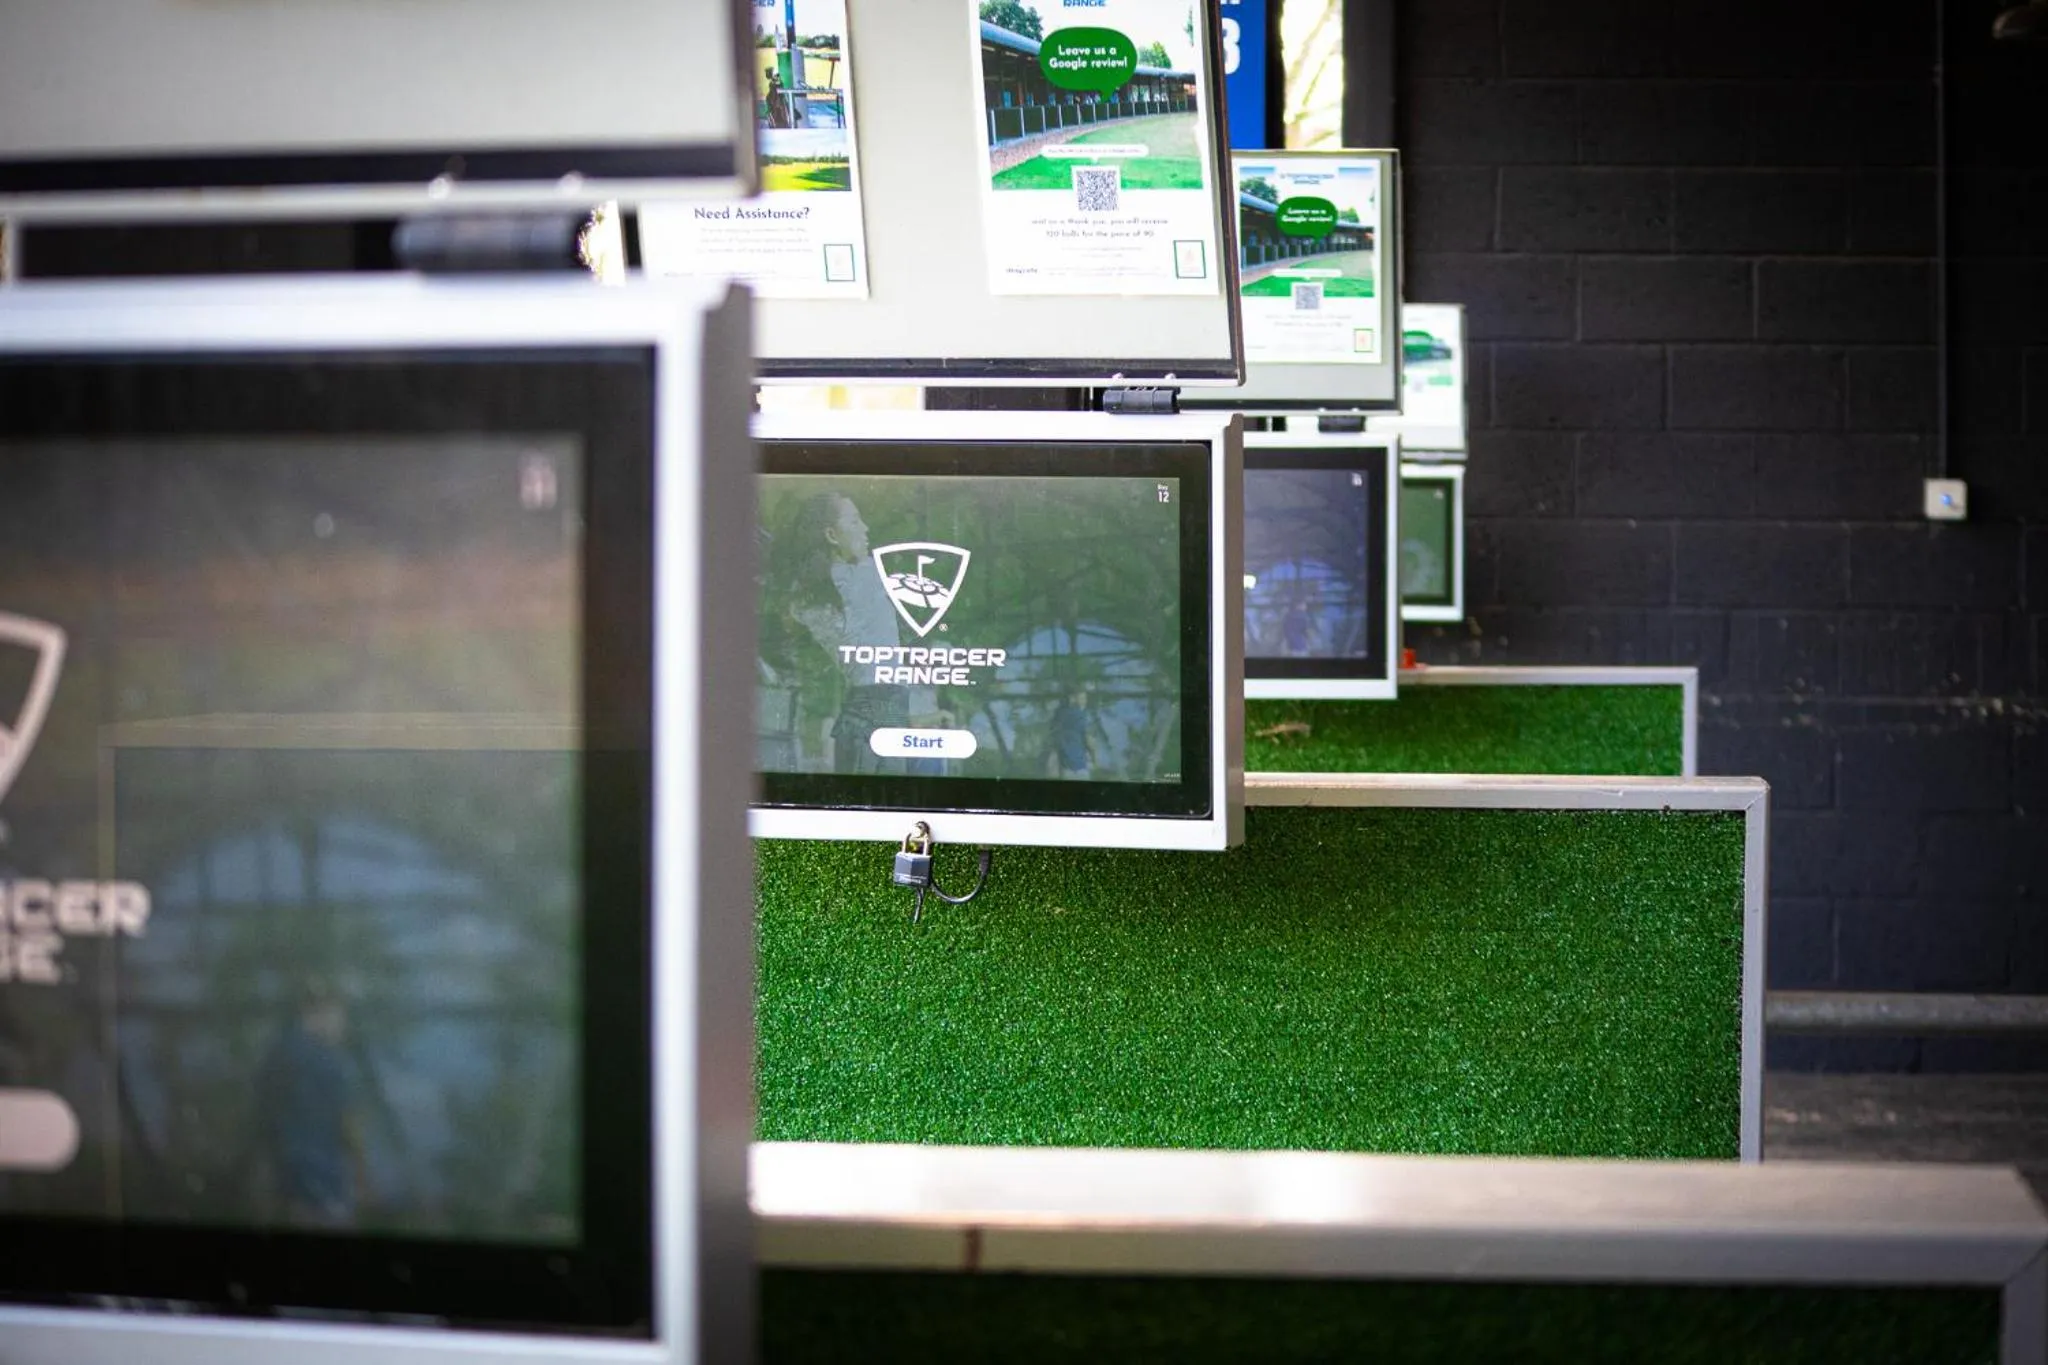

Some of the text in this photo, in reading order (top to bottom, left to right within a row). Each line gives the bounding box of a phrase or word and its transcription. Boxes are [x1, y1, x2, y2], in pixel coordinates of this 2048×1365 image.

[1058, 44, 1117, 56] Leave us a
[1049, 56, 1128, 70] Google review!
[694, 206, 810, 219] Need Assistance?
[1158, 491, 1169, 503] 12
[838, 644, 1006, 667] TOPTRACER
[874, 666, 971, 686] RANGE
[902, 734, 944, 749] Start
